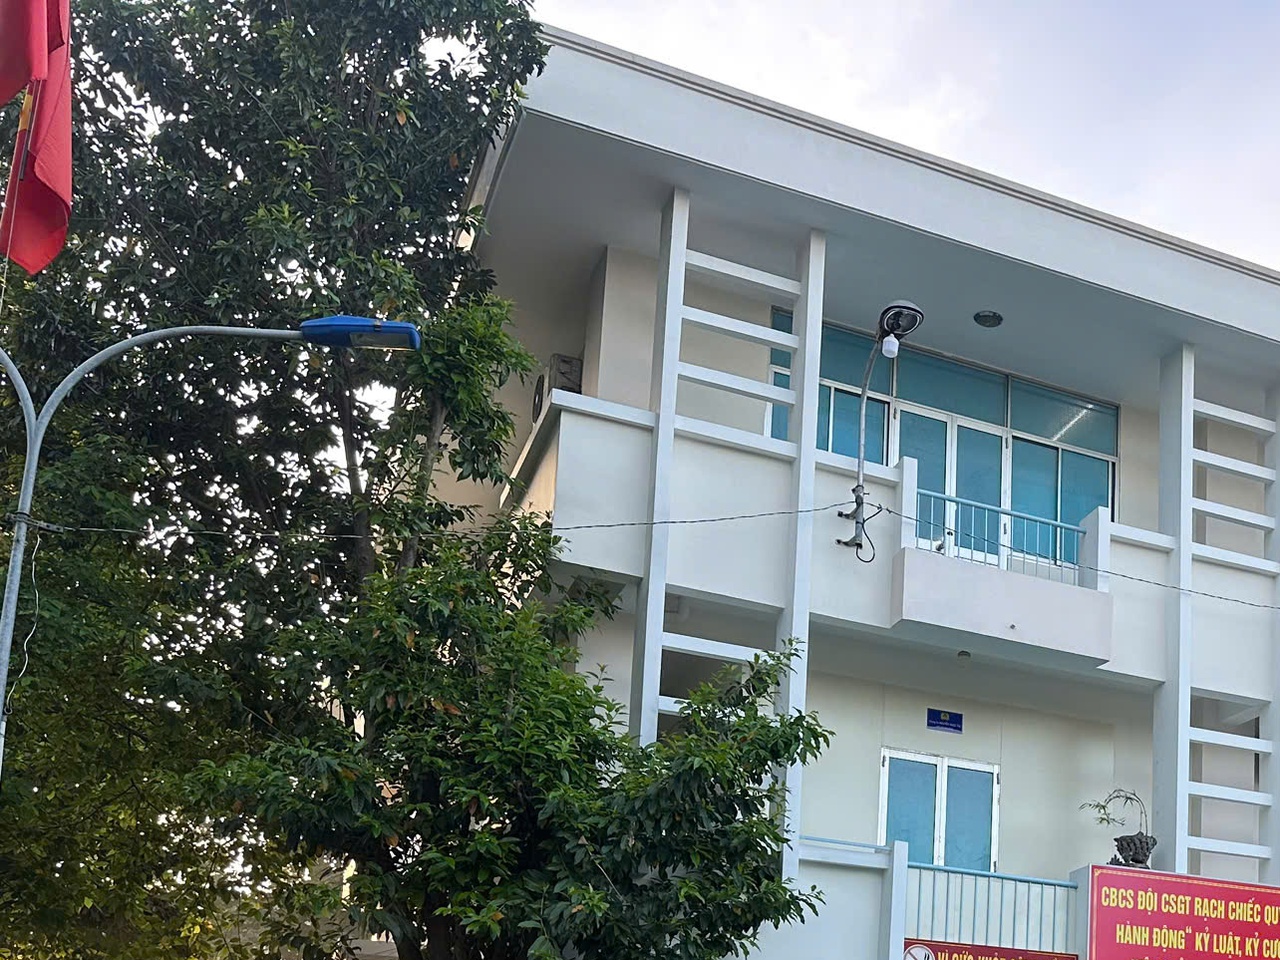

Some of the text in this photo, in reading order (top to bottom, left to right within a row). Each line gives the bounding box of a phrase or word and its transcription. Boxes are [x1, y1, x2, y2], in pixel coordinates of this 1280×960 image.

[1101, 886, 1134, 909] CBCS
[1137, 888, 1158, 915] ĐỘI
[1161, 893, 1191, 915] CSGT
[1194, 896, 1225, 921] RẠCH
[1228, 897, 1261, 923] CHIẾC
[1116, 920, 1150, 947] HÀNH
[1195, 926, 1210, 952] KỶ
[1213, 931, 1242, 959] LUẬT,
[1245, 932, 1260, 957] KỶ
